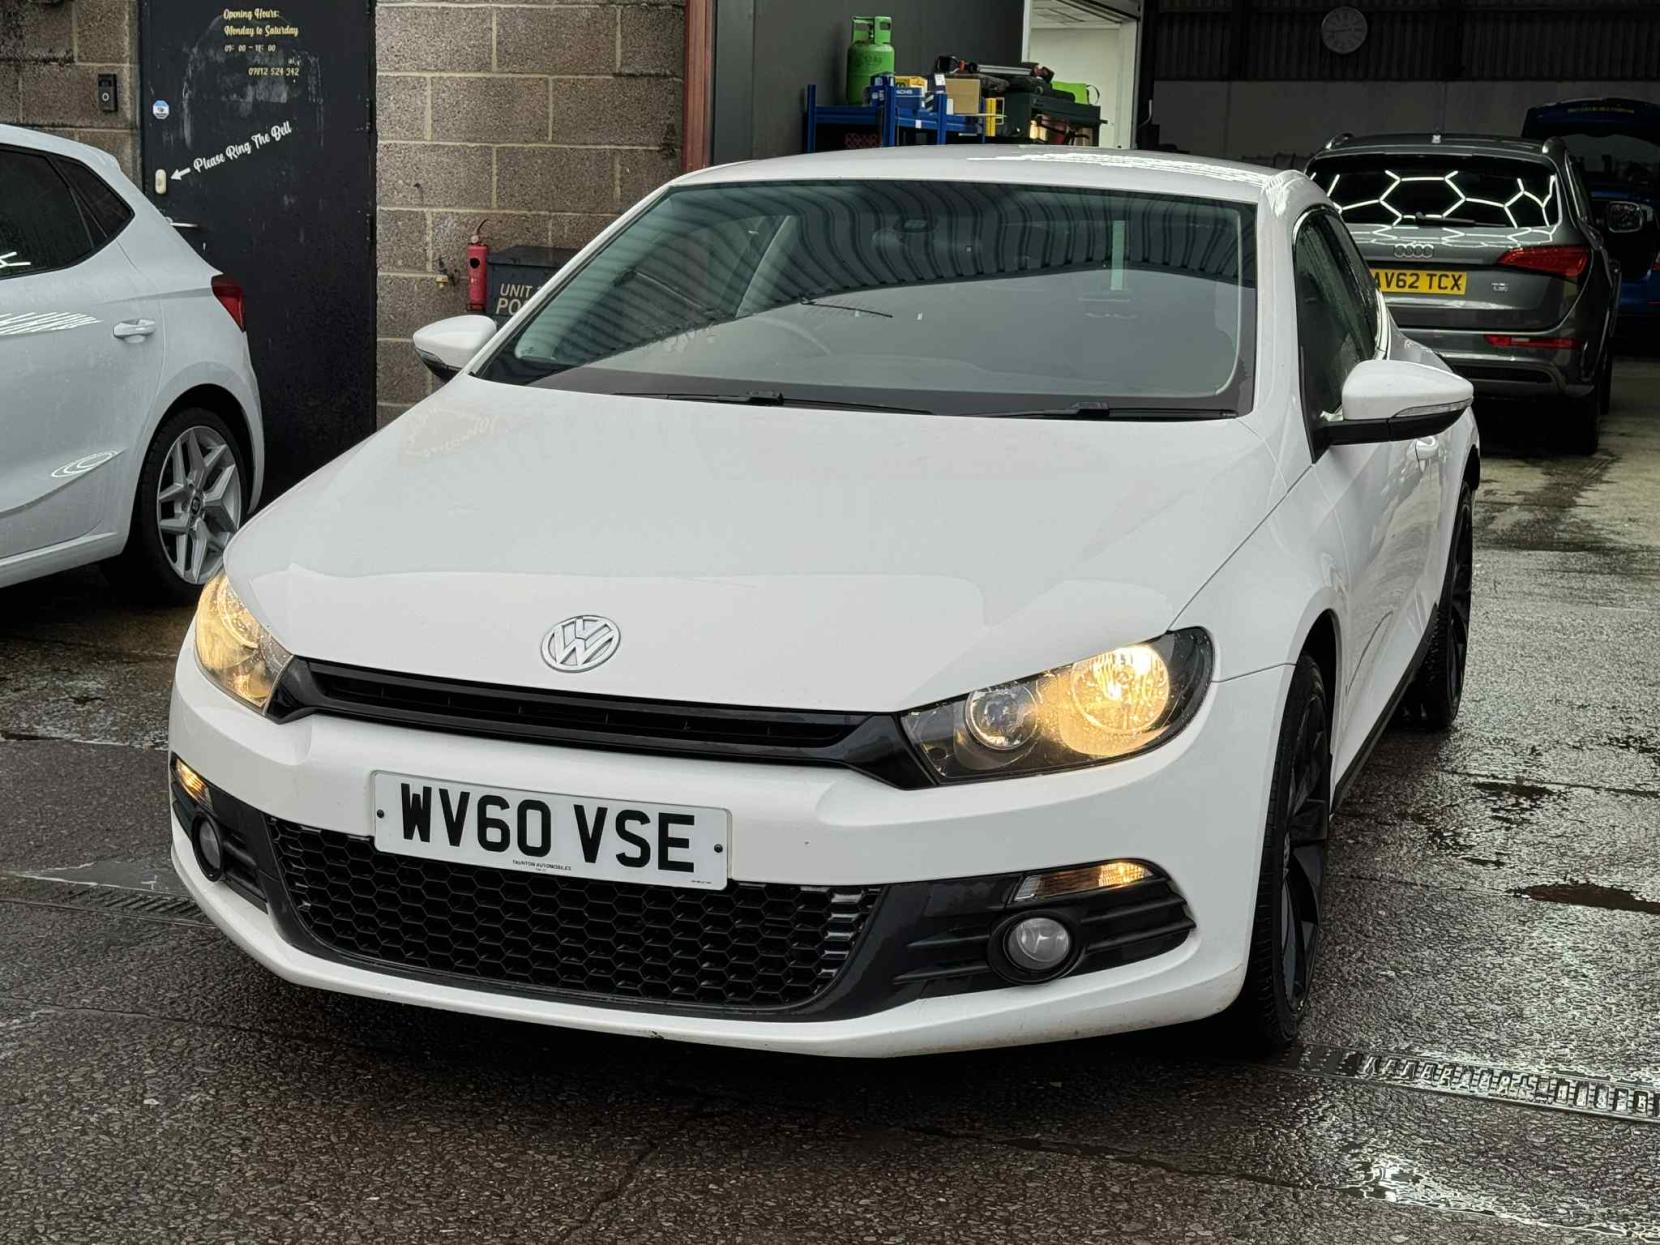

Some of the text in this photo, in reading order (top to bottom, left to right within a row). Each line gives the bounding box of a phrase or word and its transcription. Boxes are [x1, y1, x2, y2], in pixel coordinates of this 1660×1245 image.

[223, 8, 253, 20] Opening
[224, 25, 299, 37] Monday to Saturday
[193, 120, 292, 173] Please Ring The Bell
[500, 283, 533, 298] UNIT
[1426, 273, 1463, 291] TCX
[495, 297, 525, 316] PO
[400, 782, 695, 873] WV60 VSE
